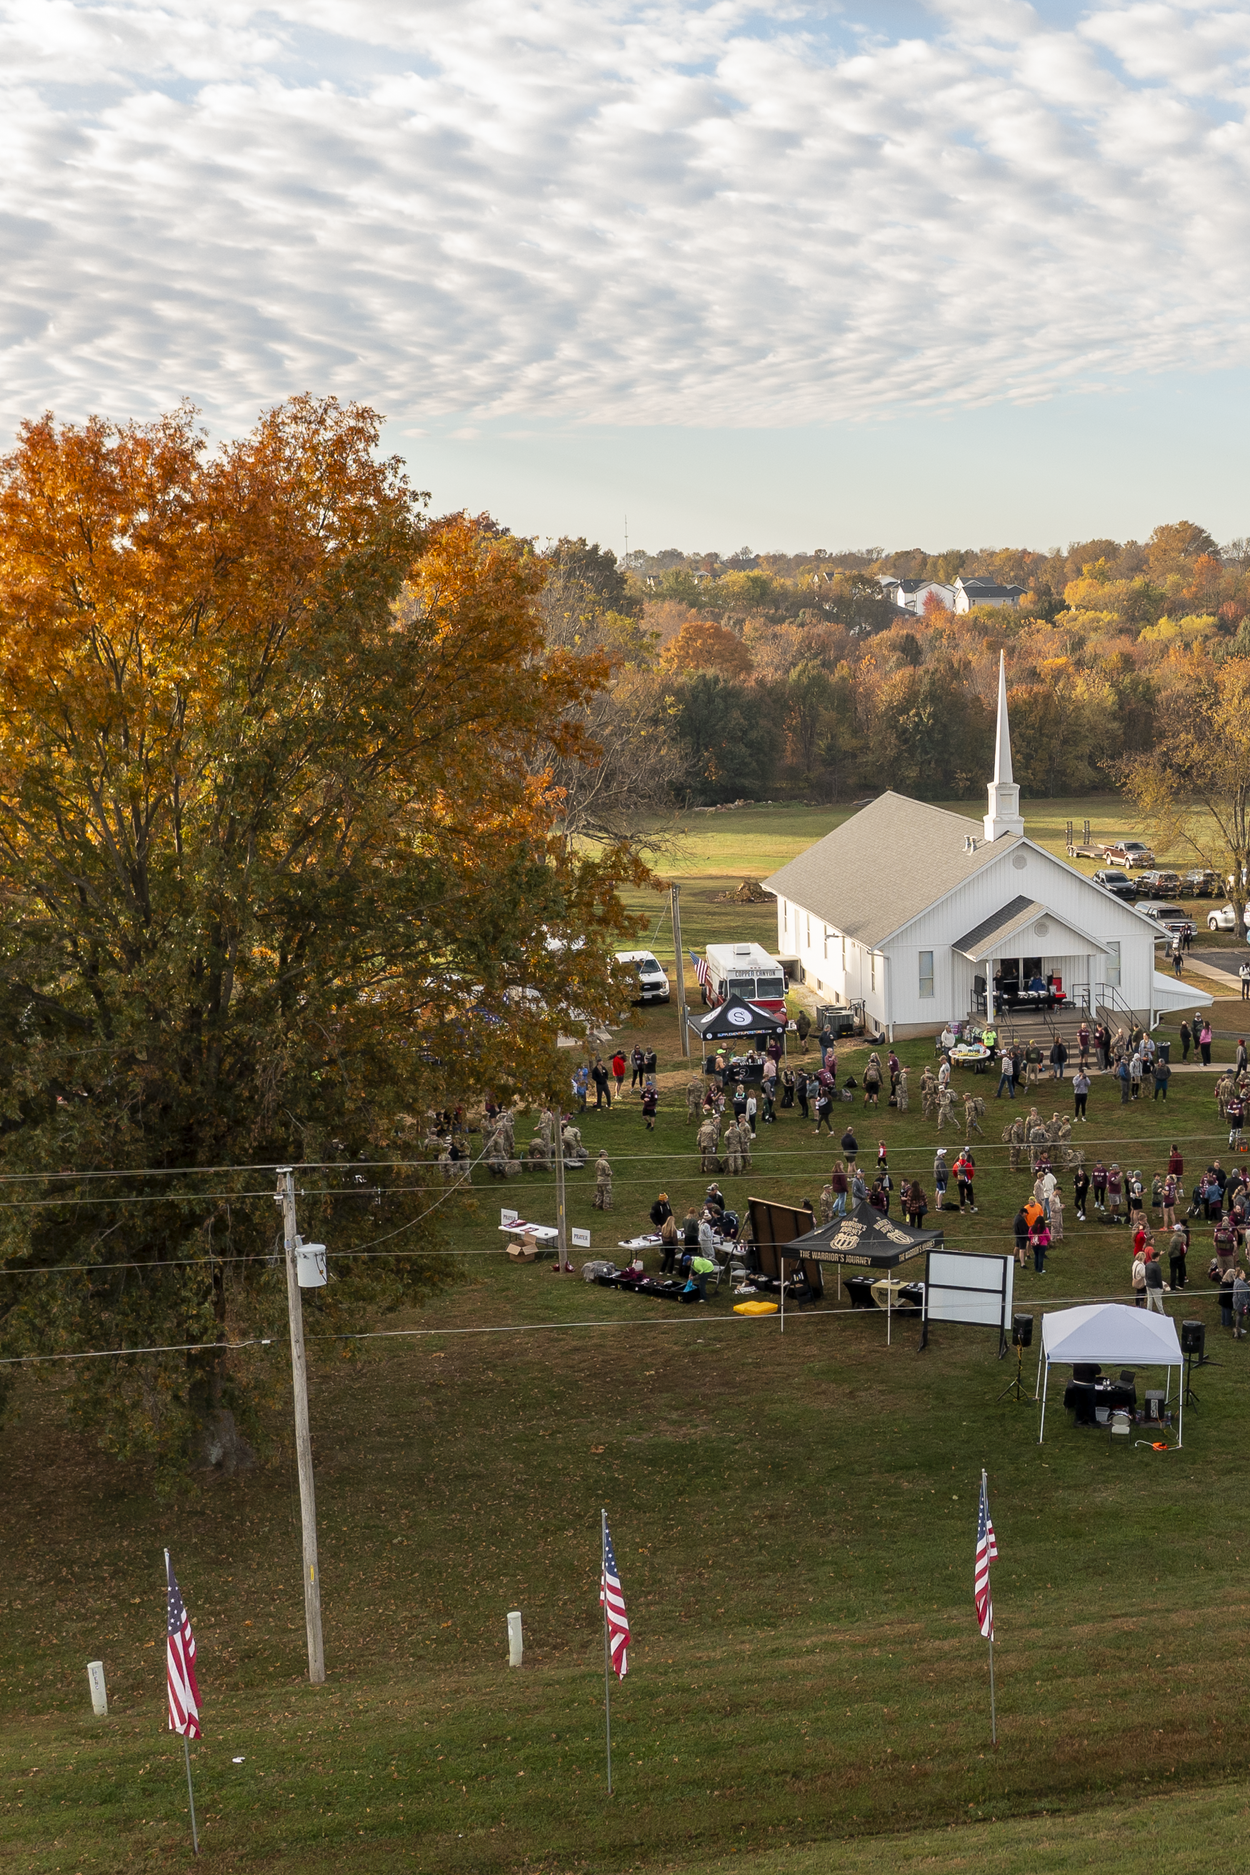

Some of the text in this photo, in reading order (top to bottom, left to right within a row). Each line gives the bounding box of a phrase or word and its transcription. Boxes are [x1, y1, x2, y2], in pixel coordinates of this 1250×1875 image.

[735, 970, 754, 978] COPPER
[799, 1250, 872, 1266] THE WARRIOR'S JOURNEY
